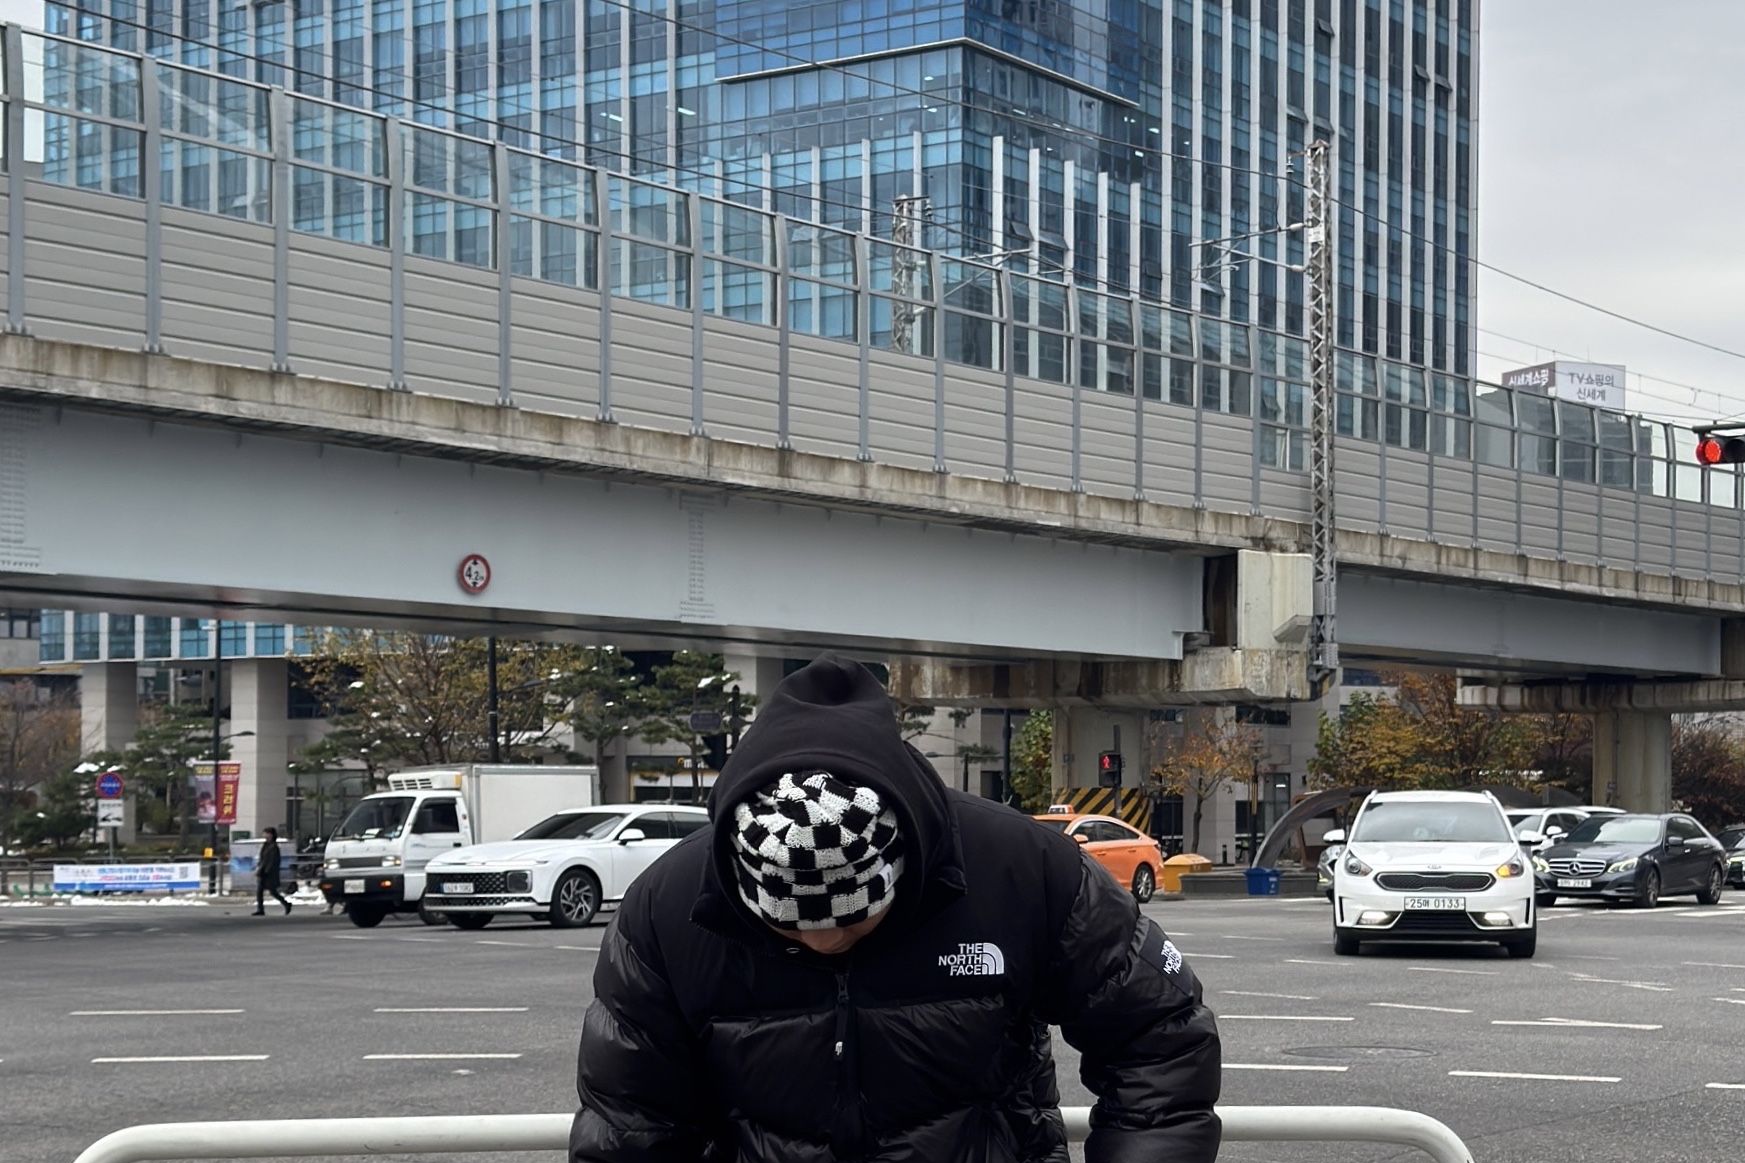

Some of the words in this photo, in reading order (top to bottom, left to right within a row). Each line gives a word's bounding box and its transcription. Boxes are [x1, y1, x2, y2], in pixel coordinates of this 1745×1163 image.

[1568, 372, 1615, 387] TV쇼핑의
[1577, 387, 1607, 401] 신세계
[1433, 899, 1460, 908] 0133
[958, 943, 983, 954] THE
[938, 954, 982, 966] NORTH
[949, 965, 982, 976] FACE
